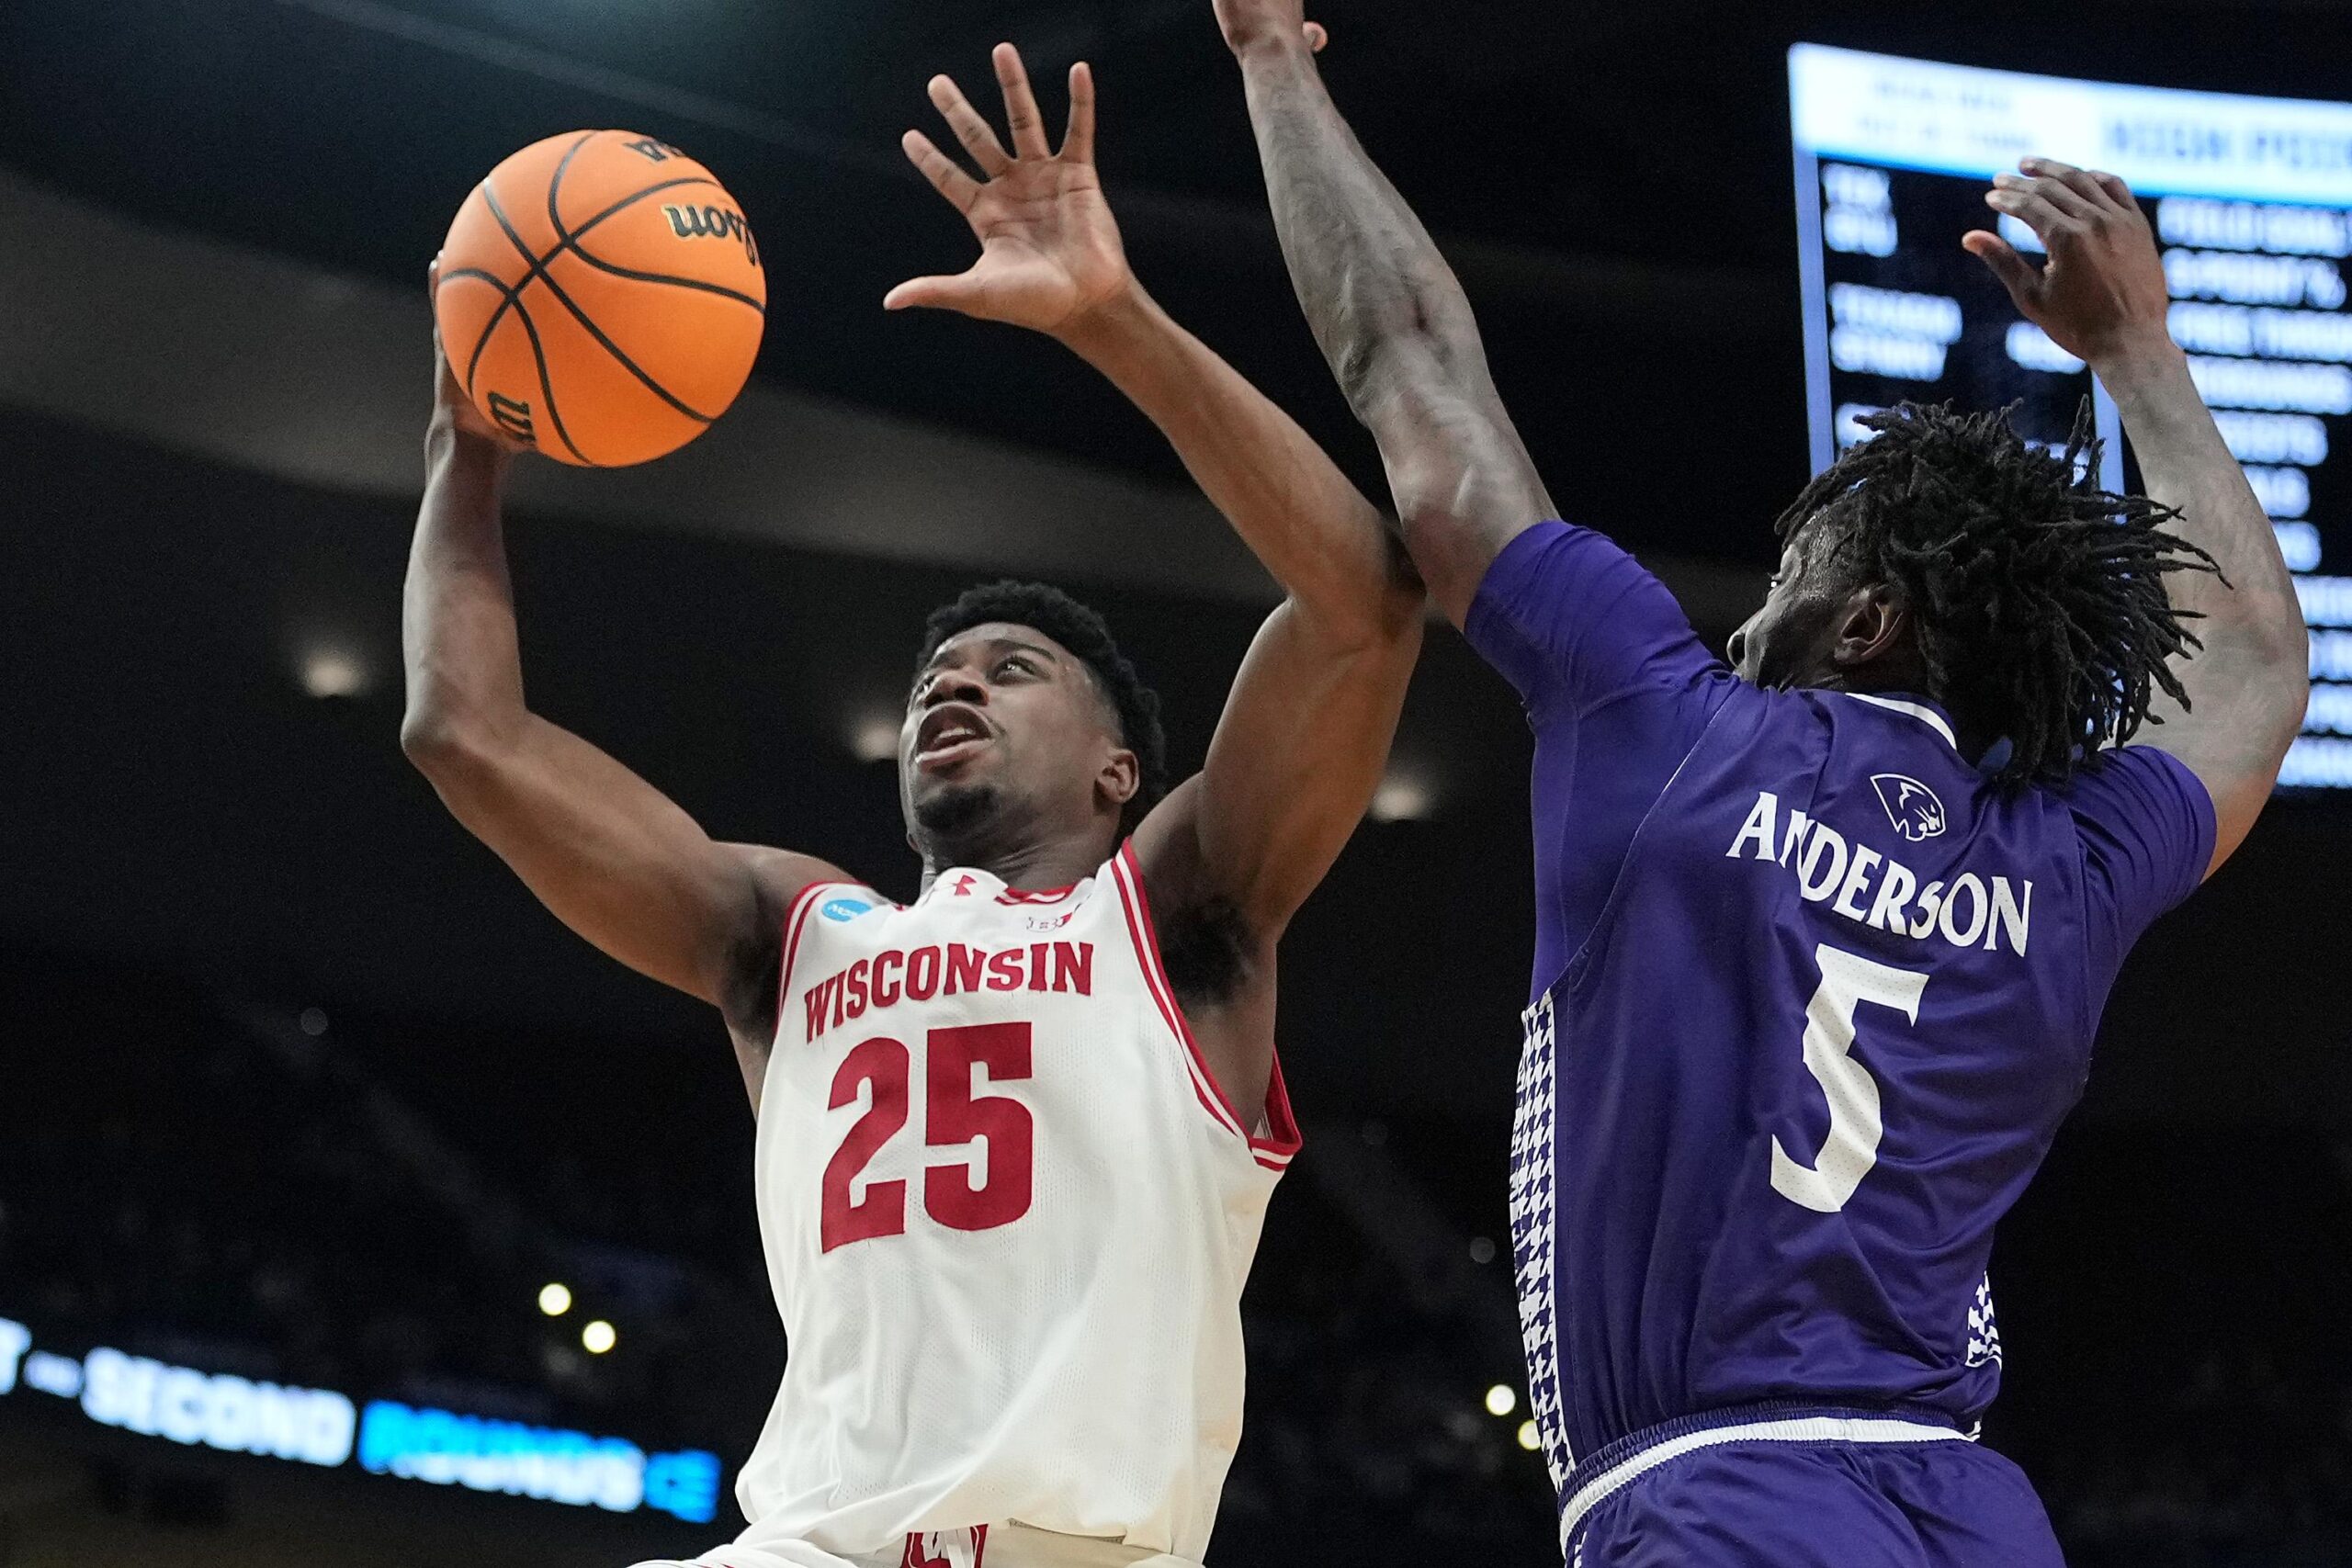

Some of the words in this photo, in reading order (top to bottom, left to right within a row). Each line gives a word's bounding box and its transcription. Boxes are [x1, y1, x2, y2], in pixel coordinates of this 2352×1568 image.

[1725, 792, 2033, 957] ANDERSON
[804, 942, 1094, 1044] WISCONSIN
[1770, 942, 1929, 1213] 5
[820, 1021, 1033, 1255] 25
